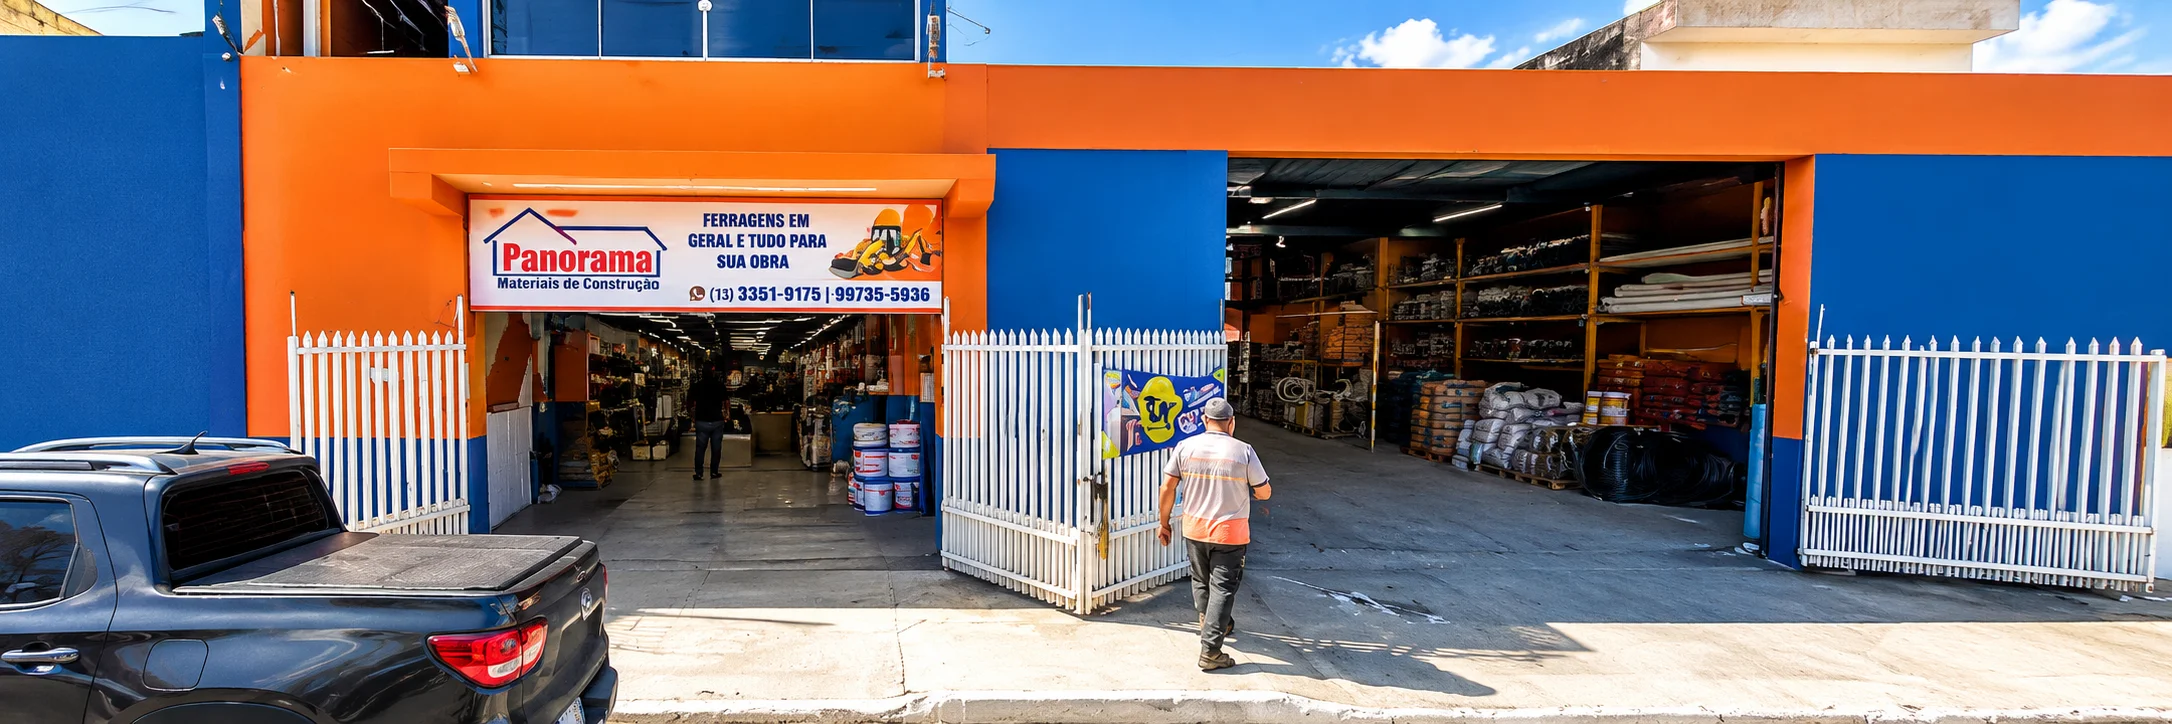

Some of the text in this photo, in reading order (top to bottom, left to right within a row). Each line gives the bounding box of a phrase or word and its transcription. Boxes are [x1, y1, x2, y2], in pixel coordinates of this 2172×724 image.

[703, 213, 810, 228] FERRAGENS EM
[688, 233, 827, 248] GERAL E TUDO PARA
[503, 243, 652, 273] Panorama
[717, 254, 789, 269] SUA OBRA
[497, 277, 560, 290] Materiais
[563, 277, 580, 290] de
[709, 287, 734, 303] (13)
[738, 286, 821, 302] 3351-9175
[835, 286, 930, 302] 99735-5936
